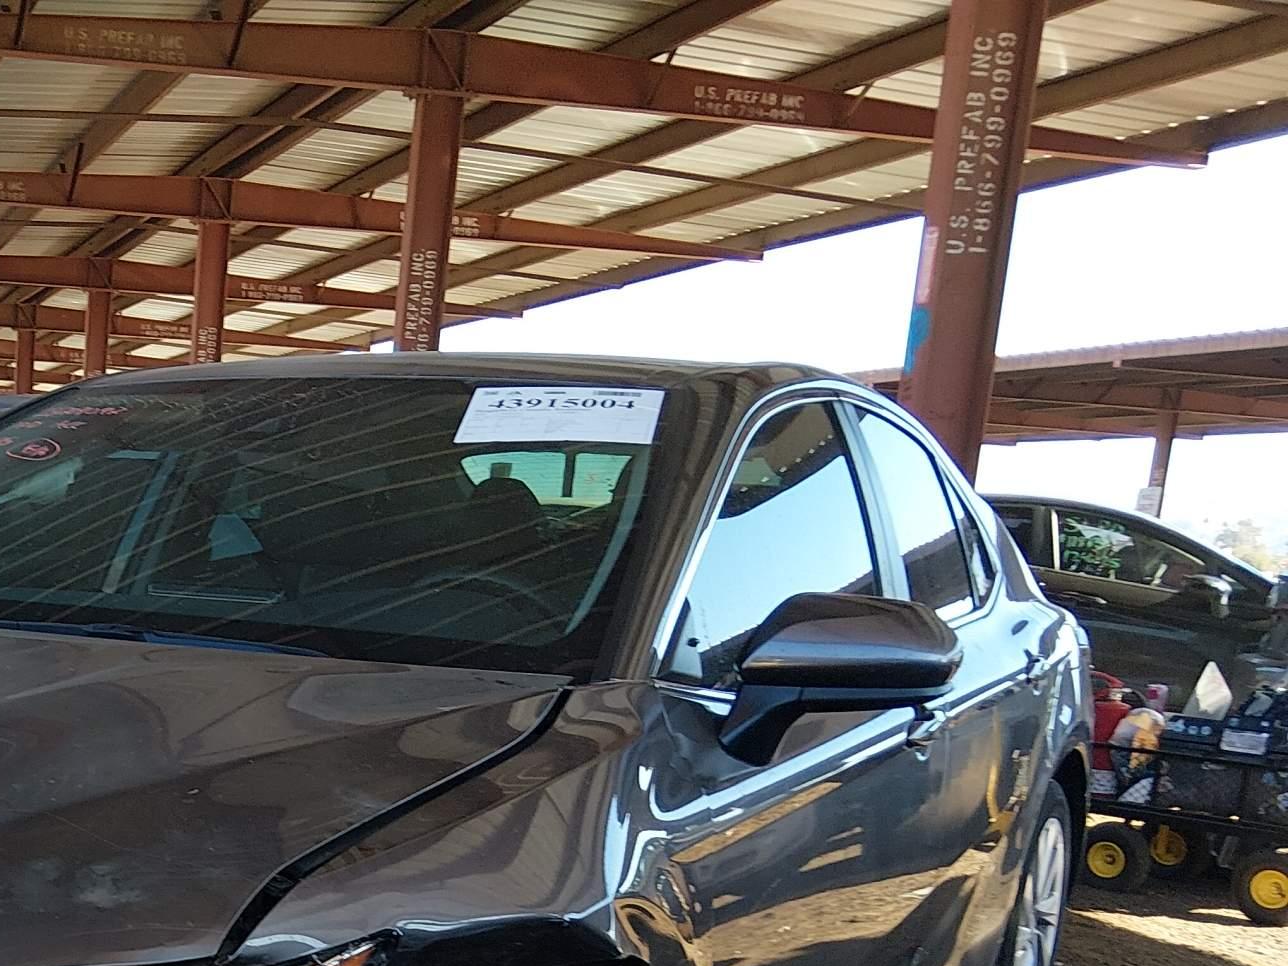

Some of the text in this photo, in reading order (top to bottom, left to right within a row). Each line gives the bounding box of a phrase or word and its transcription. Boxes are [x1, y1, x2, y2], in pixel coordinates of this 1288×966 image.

[725, 88, 778, 106] PREFAB
[945, 36, 993, 255] U.S. PREFAB INC
[967, 32, 1017, 254] 1-866-799-0969
[488, 398, 635, 410] 43915004
